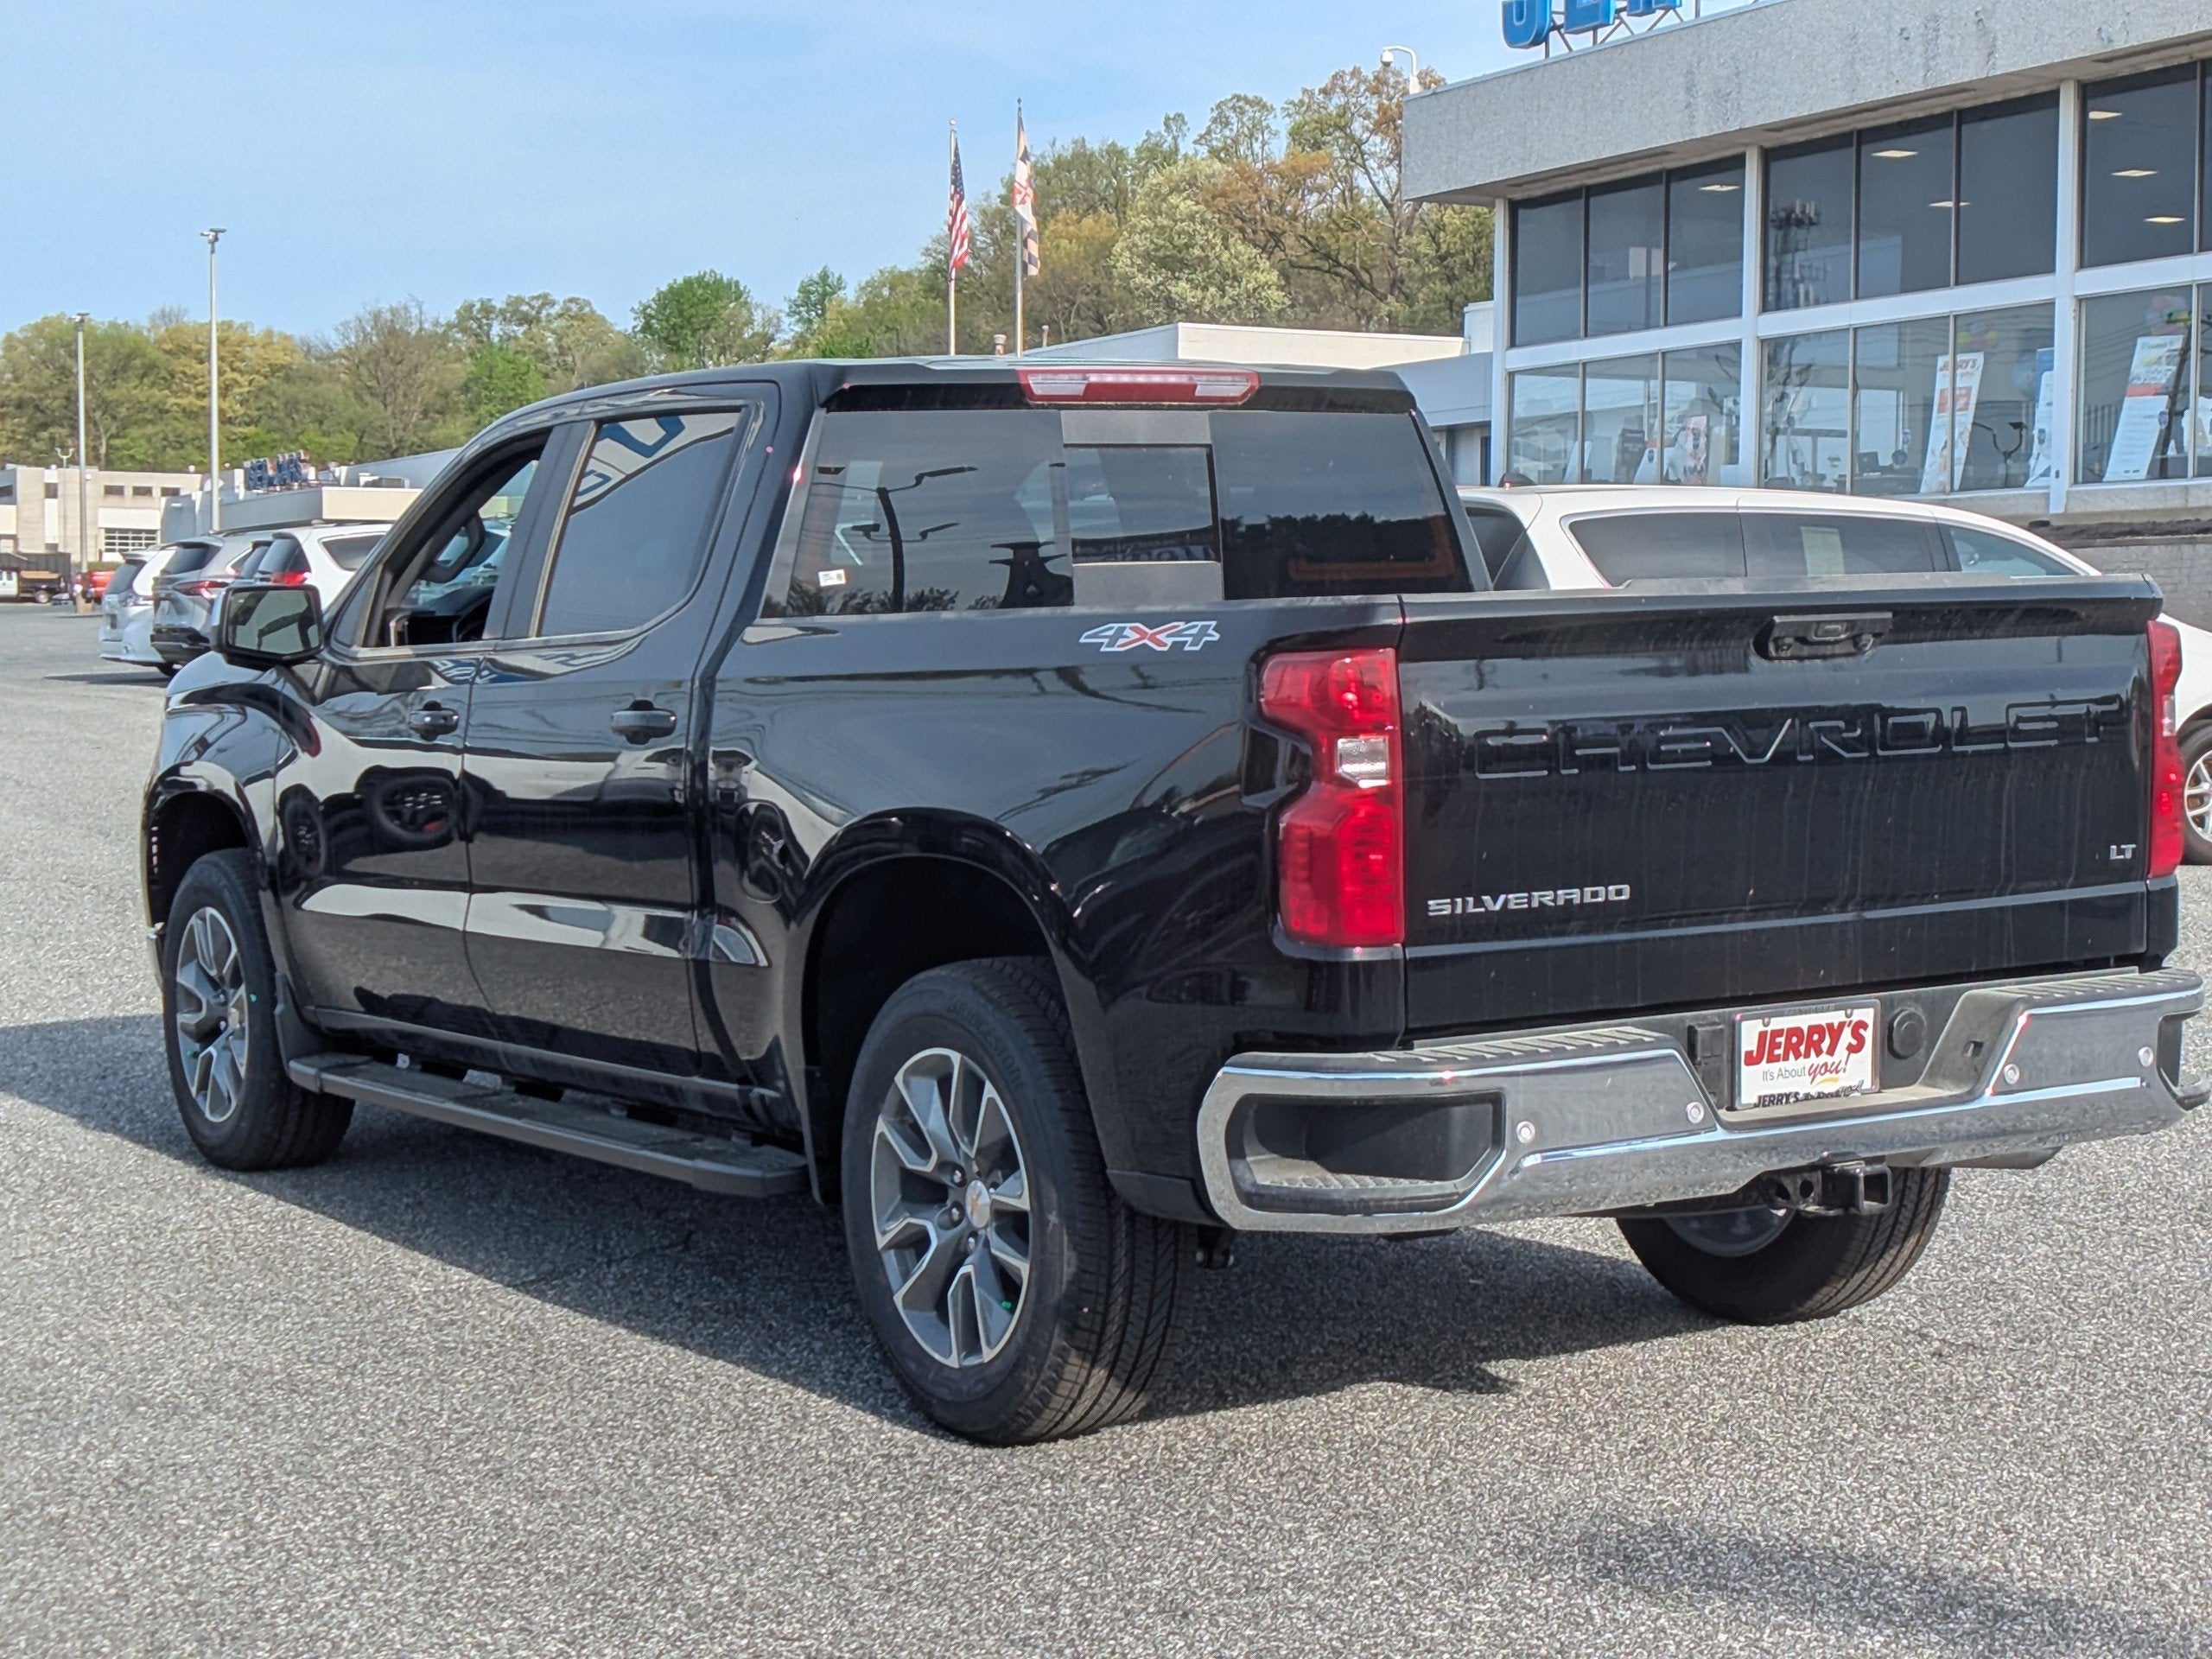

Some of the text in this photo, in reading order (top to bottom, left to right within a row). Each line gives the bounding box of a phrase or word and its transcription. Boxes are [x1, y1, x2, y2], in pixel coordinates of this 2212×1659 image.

[1473, 694, 2123, 779] CHEVROLET
[2110, 843, 2137, 860] LT
[1427, 884, 1630, 917] SILVERADO
[1744, 1020, 1869, 1066] JERRY'S
[1762, 1067, 1775, 1081] It's
[1777, 1065, 1806, 1079] About
